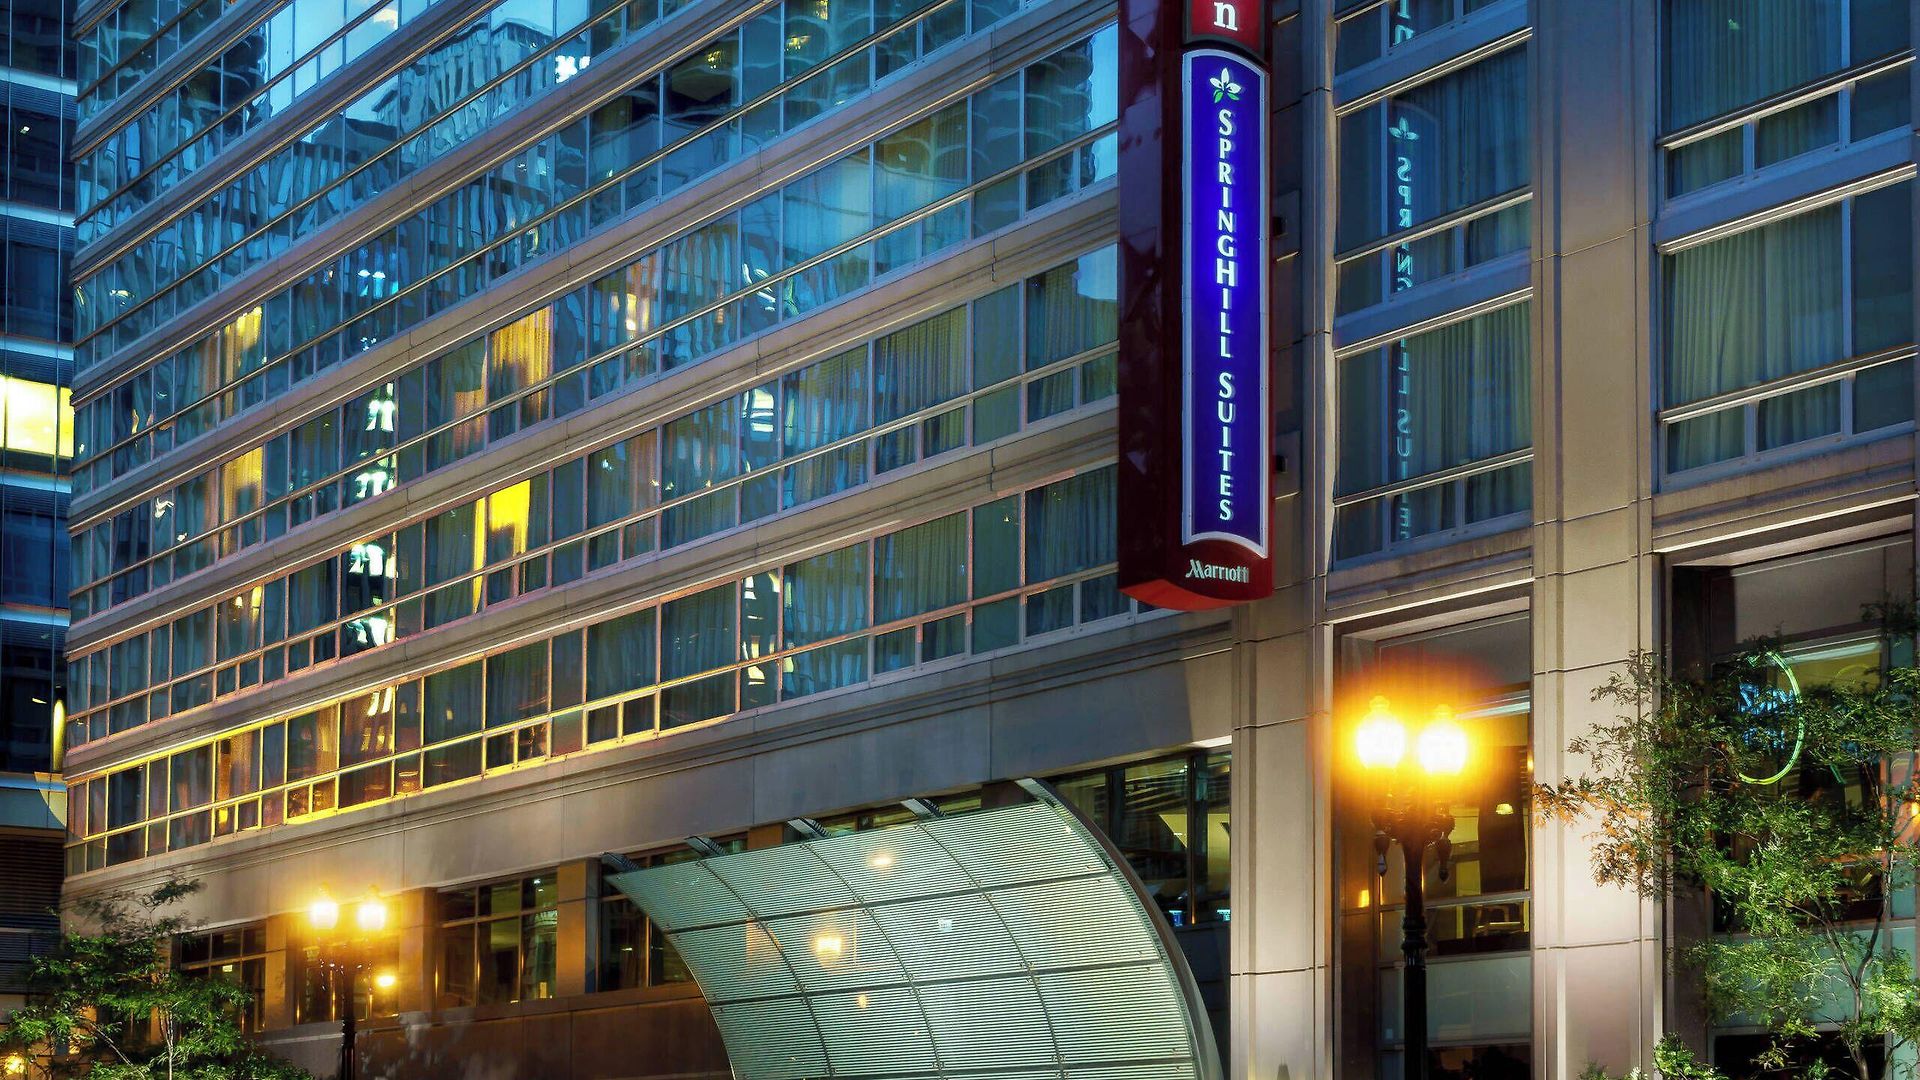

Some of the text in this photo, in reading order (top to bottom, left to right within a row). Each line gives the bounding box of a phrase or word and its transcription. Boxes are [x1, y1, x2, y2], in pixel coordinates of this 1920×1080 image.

[1216, 109, 1236, 521] SPRINGHILL SUITES
[1185, 559, 1249, 584] Marriott
